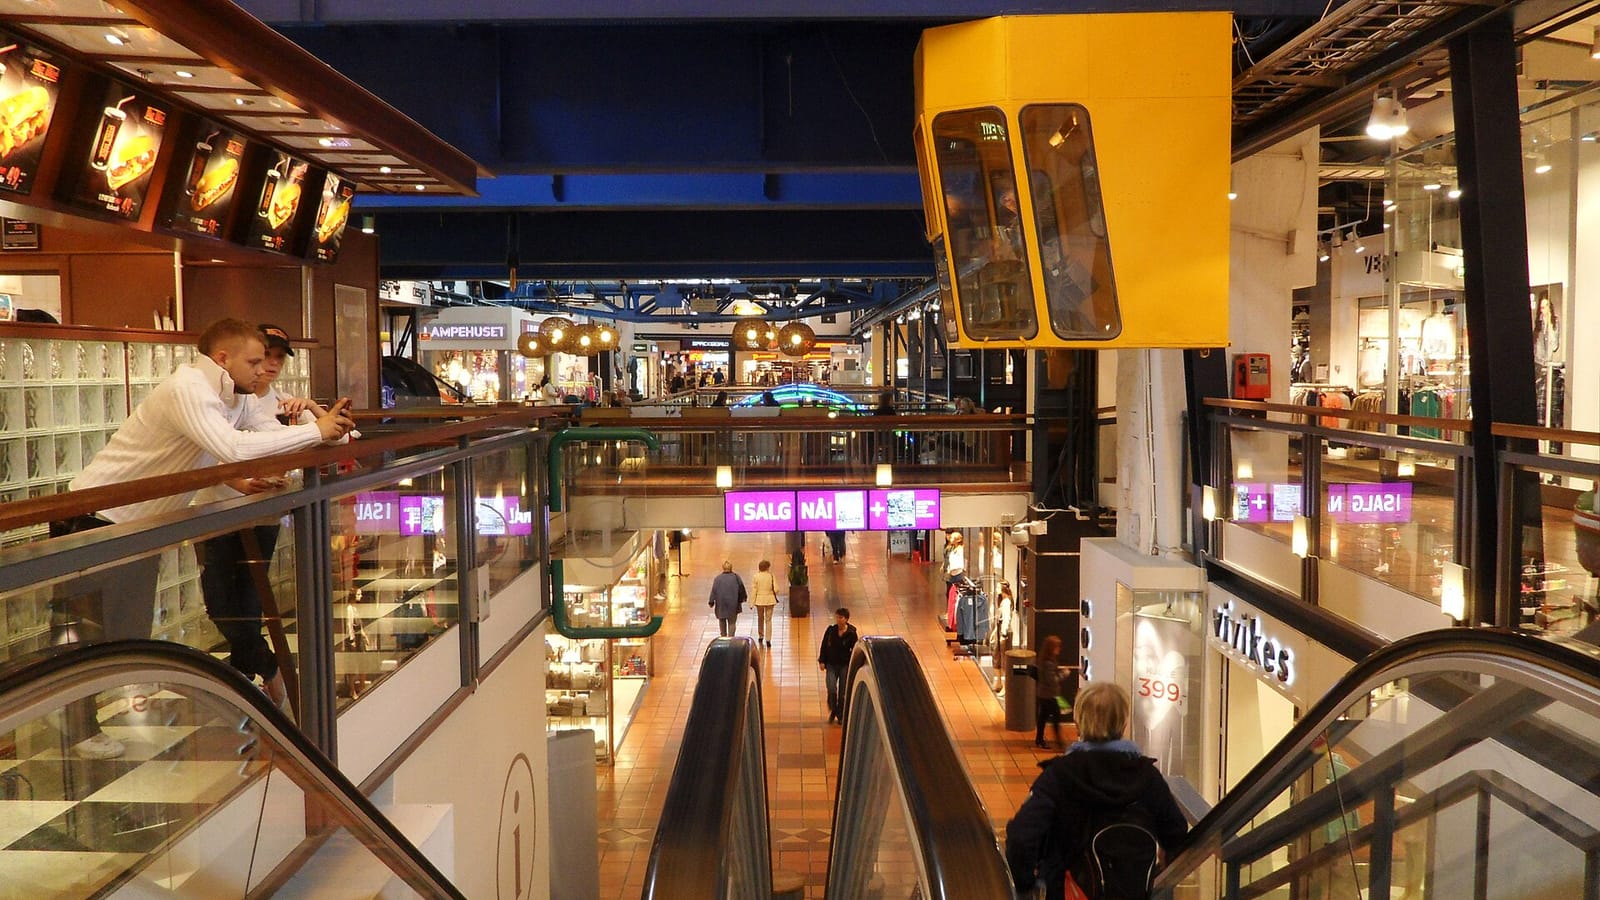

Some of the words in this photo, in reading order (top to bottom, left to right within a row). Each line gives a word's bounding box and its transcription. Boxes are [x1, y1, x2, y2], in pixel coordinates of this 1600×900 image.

[423, 326, 504, 338] LAMPEHUSET
[734, 502, 740, 521] I
[743, 501, 792, 521] SALG
[801, 497, 833, 520] NÅ!
[1213, 601, 1289, 682] vivikes
